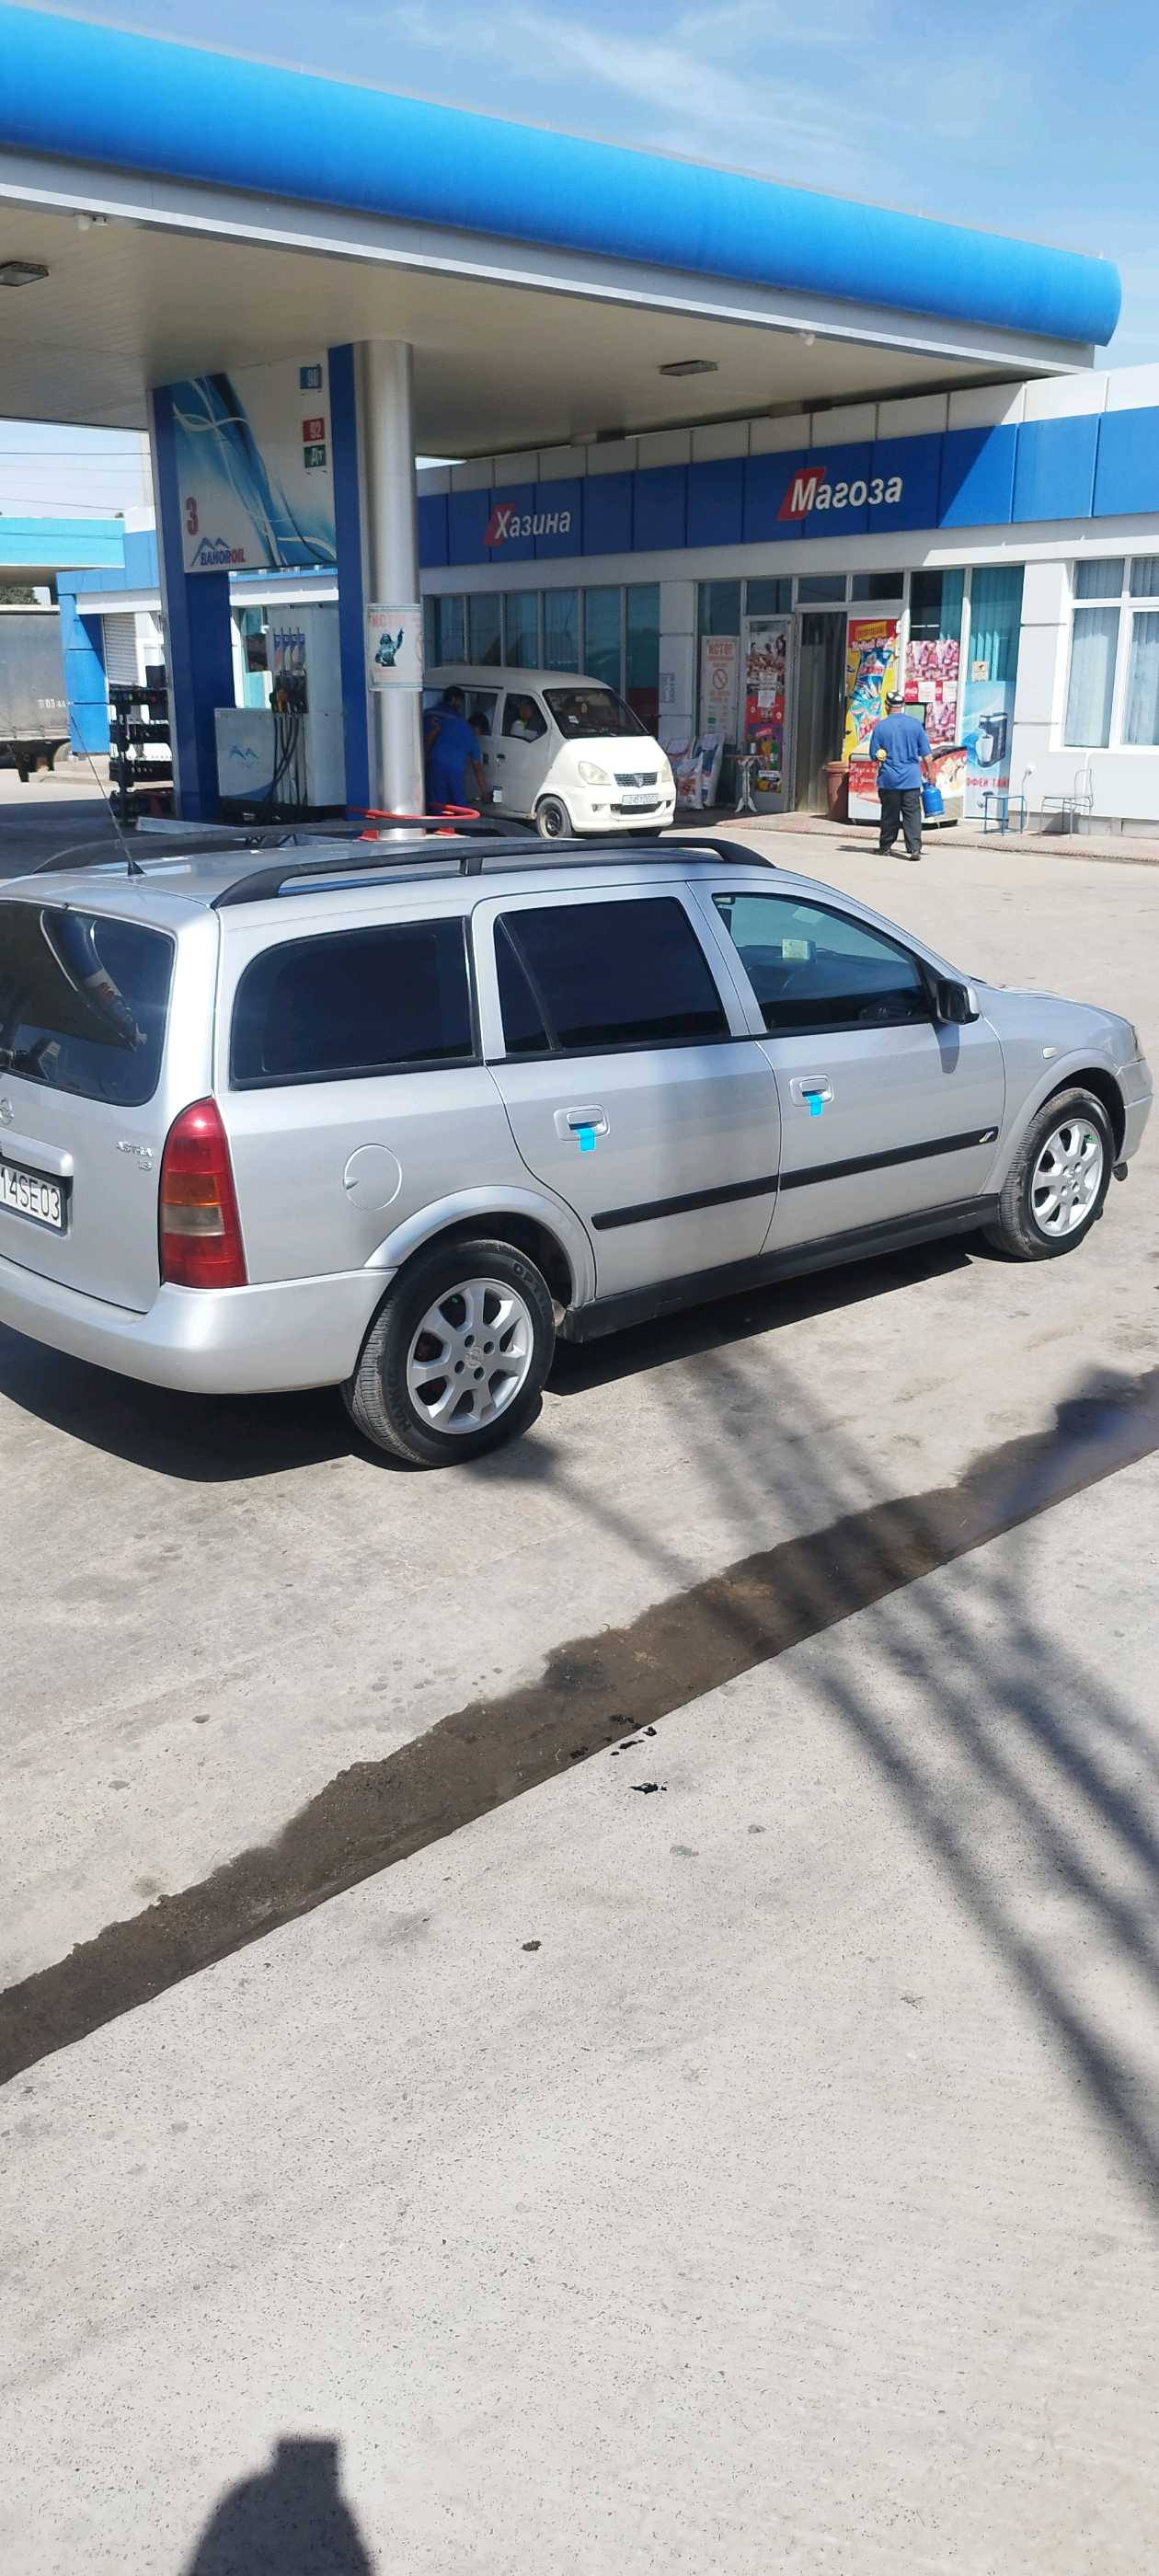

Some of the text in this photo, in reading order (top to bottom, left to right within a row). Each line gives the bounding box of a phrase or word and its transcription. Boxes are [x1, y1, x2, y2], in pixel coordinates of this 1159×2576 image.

[790, 476, 904, 513] Магоза
[186, 496, 199, 536] 3
[494, 510, 571, 540] Хазина
